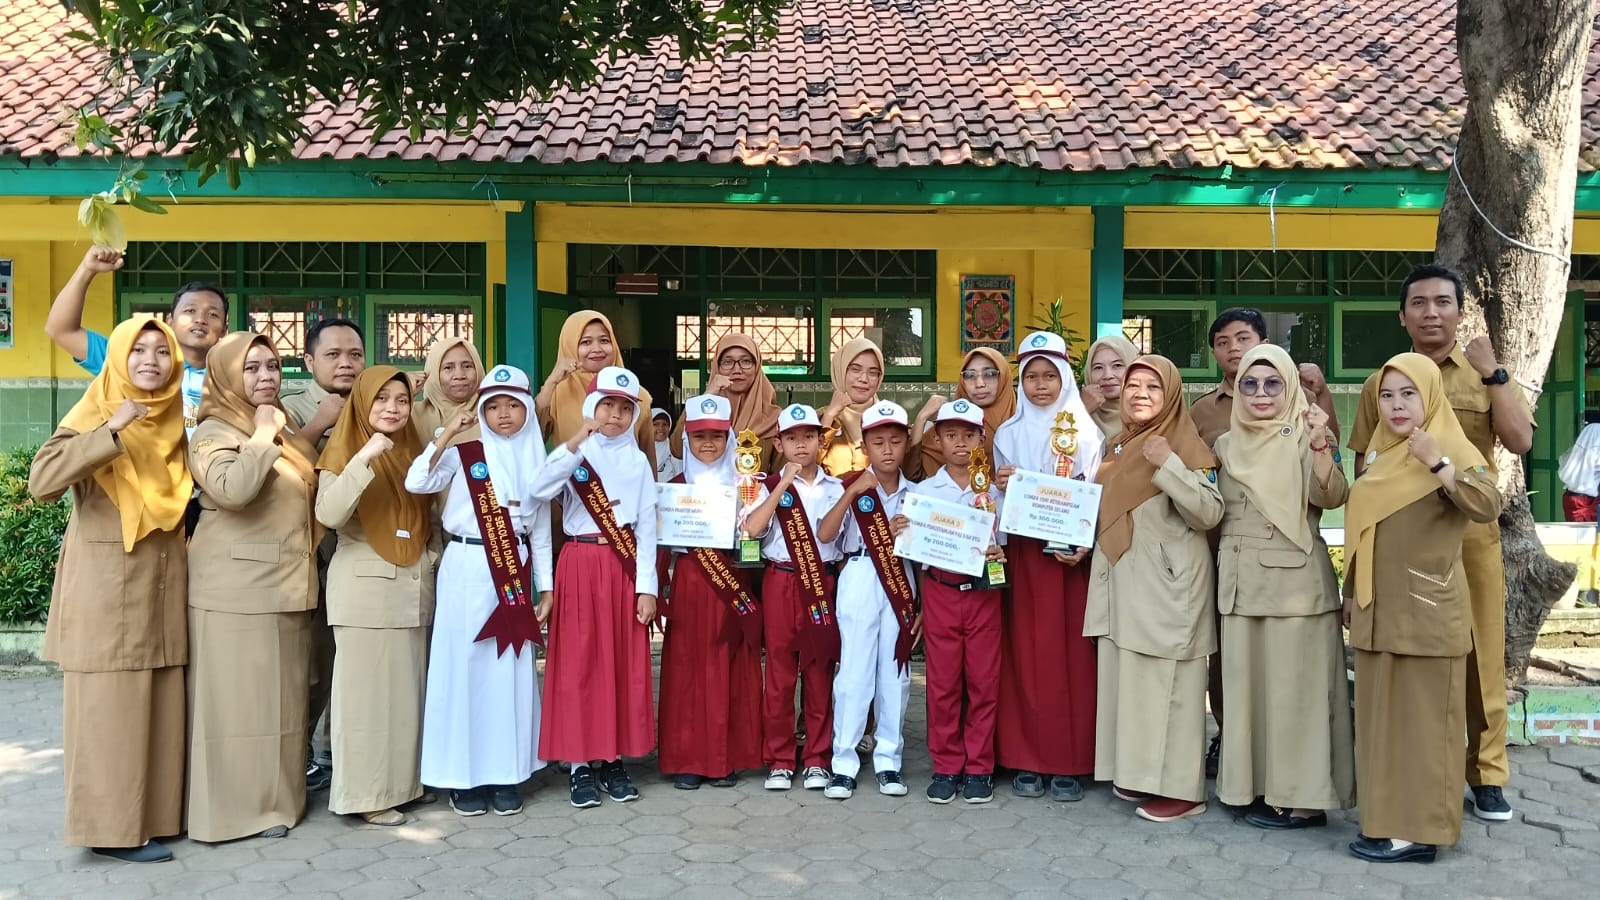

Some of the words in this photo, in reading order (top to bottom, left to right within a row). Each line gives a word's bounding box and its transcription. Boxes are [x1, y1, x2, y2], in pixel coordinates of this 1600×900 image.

[587, 494, 601, 513] Kota
[600, 513, 628, 559] Pekalongan
[934, 516, 955, 525] JUARA
[1040, 488, 1061, 497] JUARA
[478, 493, 488, 513] Kota
[484, 514, 503, 568] Pekalongan
[484, 481, 502, 514] SAHABAT
[495, 515, 512, 552] SEKOLAH
[504, 552, 518, 576] DASAR
[786, 520, 796, 540] Kota
[793, 541, 810, 590] Pekalongan
[792, 508, 808, 540] SAHABAT
[802, 540, 818, 574] SEKOLAH
[811, 572, 824, 596] DASAR
[868, 525, 880, 545] Kota
[876, 546, 898, 595] Pekalongan
[873, 512, 891, 546] SAHABAT
[898, 575, 910, 600] DASAR
[721, 569, 740, 591] DASAR
